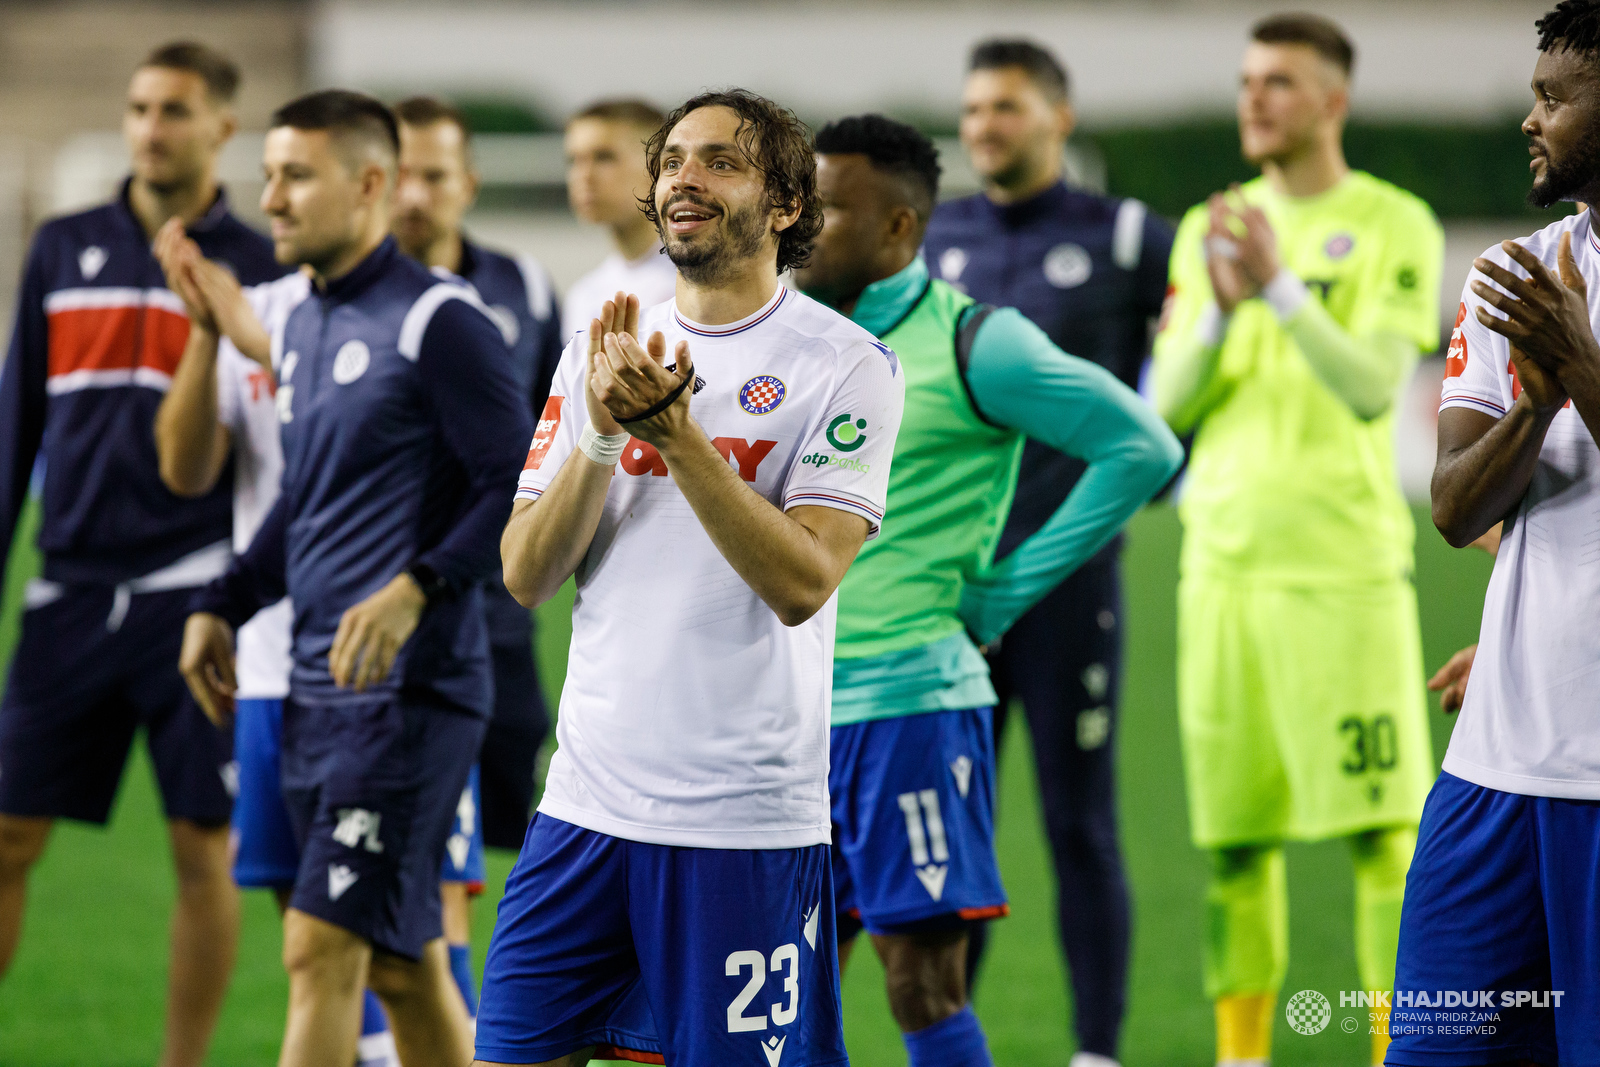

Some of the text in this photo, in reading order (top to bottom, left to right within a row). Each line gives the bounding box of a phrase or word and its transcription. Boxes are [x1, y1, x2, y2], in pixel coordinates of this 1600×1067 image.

[743, 402, 771, 414] SPLIT
[747, 376, 784, 391] HAJDUK
[1338, 714, 1398, 774] 30
[897, 788, 950, 866] 11
[724, 942, 799, 1033] 23
